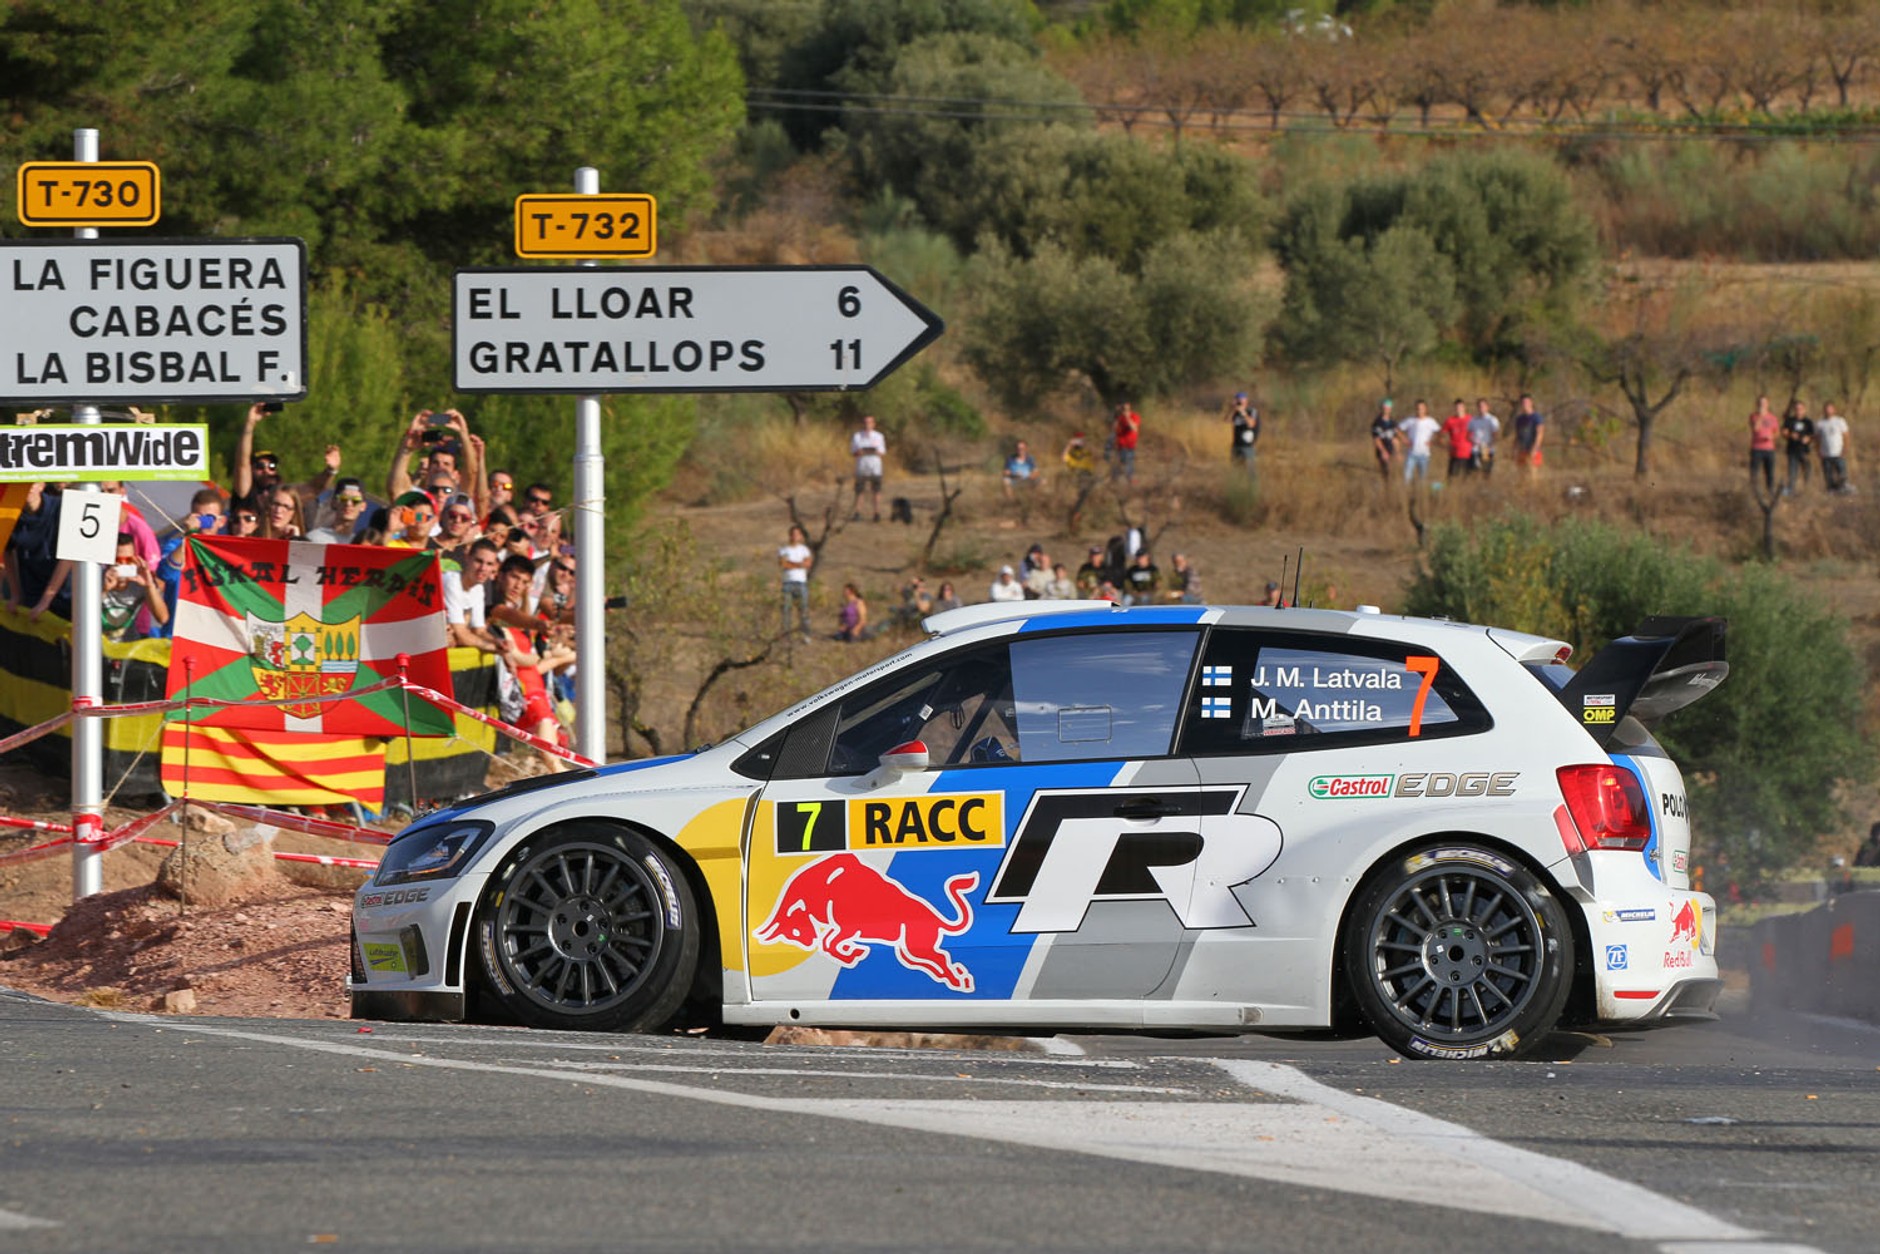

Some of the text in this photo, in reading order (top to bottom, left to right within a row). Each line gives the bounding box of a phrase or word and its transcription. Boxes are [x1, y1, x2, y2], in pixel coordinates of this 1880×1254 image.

[37, 180, 140, 207] T-730
[531, 212, 641, 240] T-732
[13, 258, 286, 291] LA FIGUERA
[469, 285, 862, 319] EL LLOAR 6
[69, 297, 287, 338] CABACÉS
[16, 350, 288, 384] LA BISBAL F.
[469, 338, 862, 374] GRATALLOPS 11
[79, 502, 101, 539] 5
[1251, 667, 1402, 690] J. M. Latvala
[1294, 698, 1383, 722] Anttila
[1405, 656, 1439, 737] 7
[1583, 709, 1616, 721] OMP
[1329, 772, 1520, 798] Castrol EDGE
[797, 799, 986, 850] 7 RACC
[383, 887, 431, 906] EDGE
[1610, 950, 1625, 965] ZF
